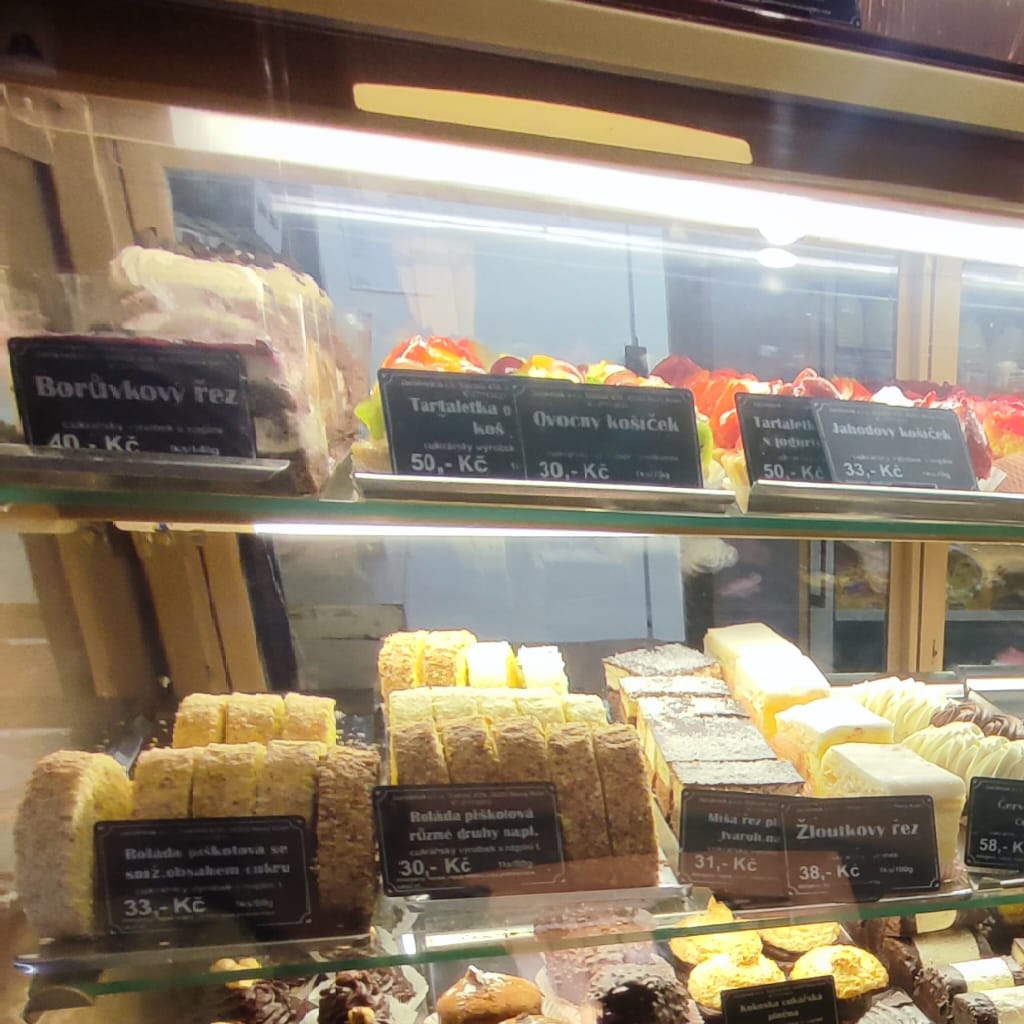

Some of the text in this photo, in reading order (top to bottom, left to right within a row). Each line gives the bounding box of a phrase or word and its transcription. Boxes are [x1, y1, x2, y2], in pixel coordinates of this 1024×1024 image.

[194, 379, 240, 406] řez
[410, 396, 499, 417] Tartaletka
[411, 453, 489, 475] 50,- Kč
[539, 460, 610, 481] 30,- Kč
[801, 465, 825, 481] Kč
[843, 461, 877, 480] 33,-
[879, 463, 904, 479] Kč
[456, 826, 500, 842] druhy
[892, 818, 920, 837] řez
[979, 837, 1009, 855] 58,-
[398, 858, 473, 879] 30,- Kč
[694, 853, 758, 873] 31,- Kč
[799, 862, 861, 883] 38,- Kč
[122, 896, 208, 919] 33,- Kč
